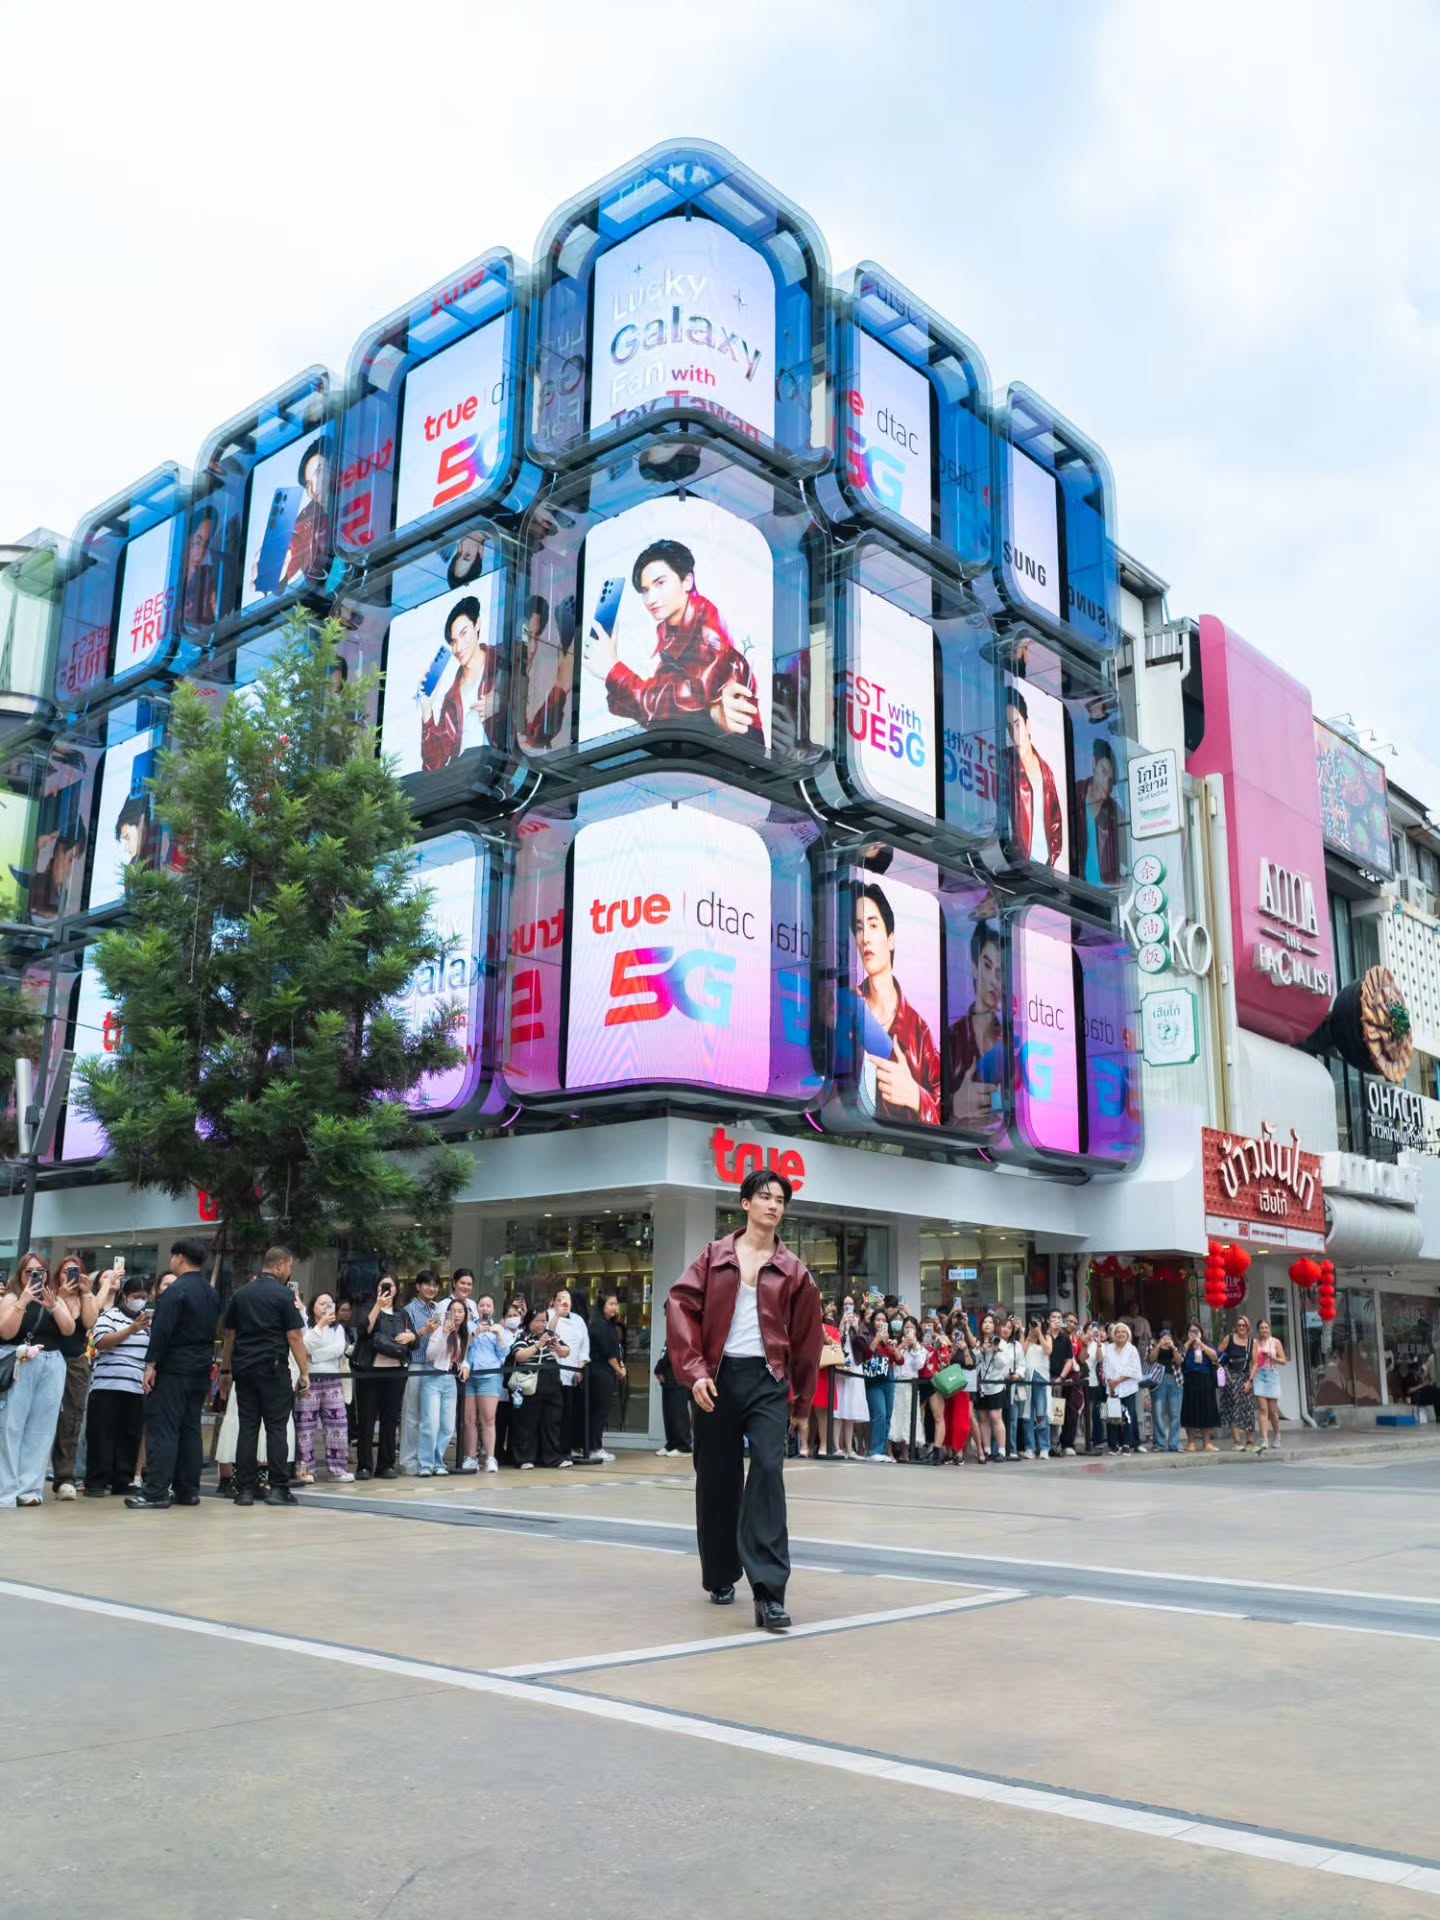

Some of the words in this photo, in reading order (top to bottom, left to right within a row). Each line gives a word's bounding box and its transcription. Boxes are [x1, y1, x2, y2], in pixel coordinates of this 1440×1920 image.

[610, 304, 763, 383] Galaxy
[672, 364, 717, 387] with
[424, 395, 479, 442] true
[876, 407, 920, 456] dtac
[1003, 541, 1046, 587] SUNG
[887, 703, 922, 733] with
[589, 893, 671, 935] true
[696, 891, 755, 940] dtac
[604, 946, 737, 1028] 5G
[1258, 943, 1333, 997] FACIALIST
[1028, 991, 1065, 1031] dtac
[1219, 1120, 1320, 1212] ข้าวมันไก่
